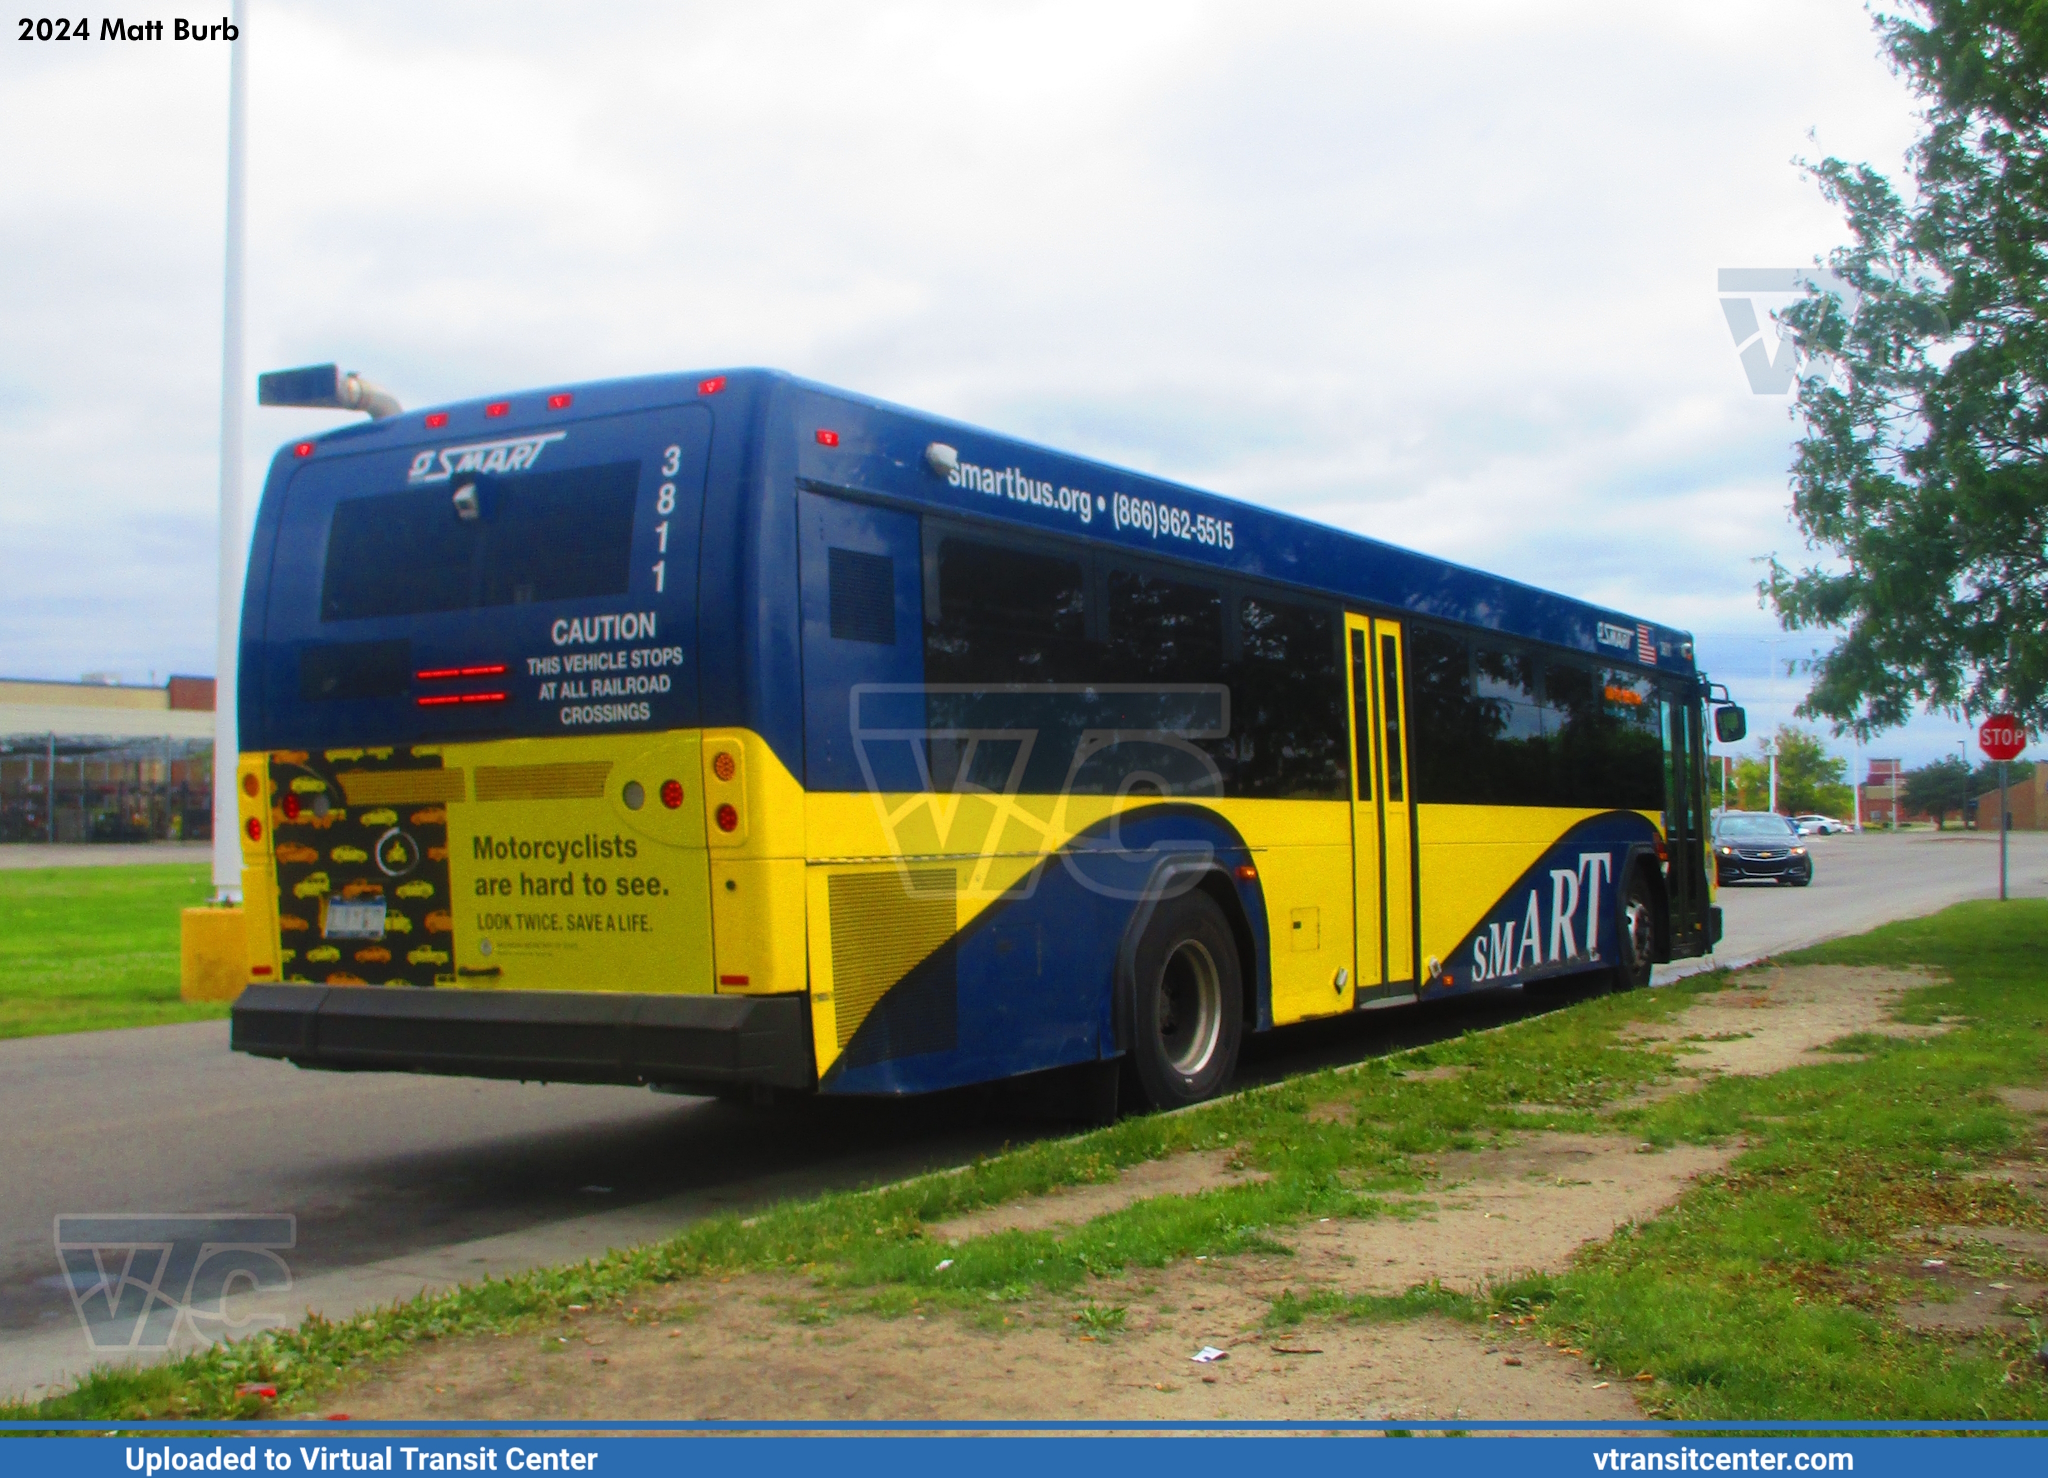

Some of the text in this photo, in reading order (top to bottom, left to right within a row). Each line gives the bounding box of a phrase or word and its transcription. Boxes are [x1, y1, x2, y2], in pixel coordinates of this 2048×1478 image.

[424, 430, 568, 482] SMART
[652, 444, 682, 594] 3811
[948, 461, 1235, 550] smartbus.org (866)962-5515
[551, 611, 657, 646] CAUTION
[526, 646, 684, 676] THIS VEHICLE STOPS
[538, 674, 671, 701] AT ALL RAILROAD
[560, 702, 650, 725] CROSSINGS
[1982, 727, 2024, 747] STOP
[473, 834, 638, 864] Motorcyclists
[475, 871, 669, 896] are hard to see.
[477, 913, 653, 932] LOOK TWICE. SAVE A LIFE.
[1472, 852, 1612, 982] SMART
